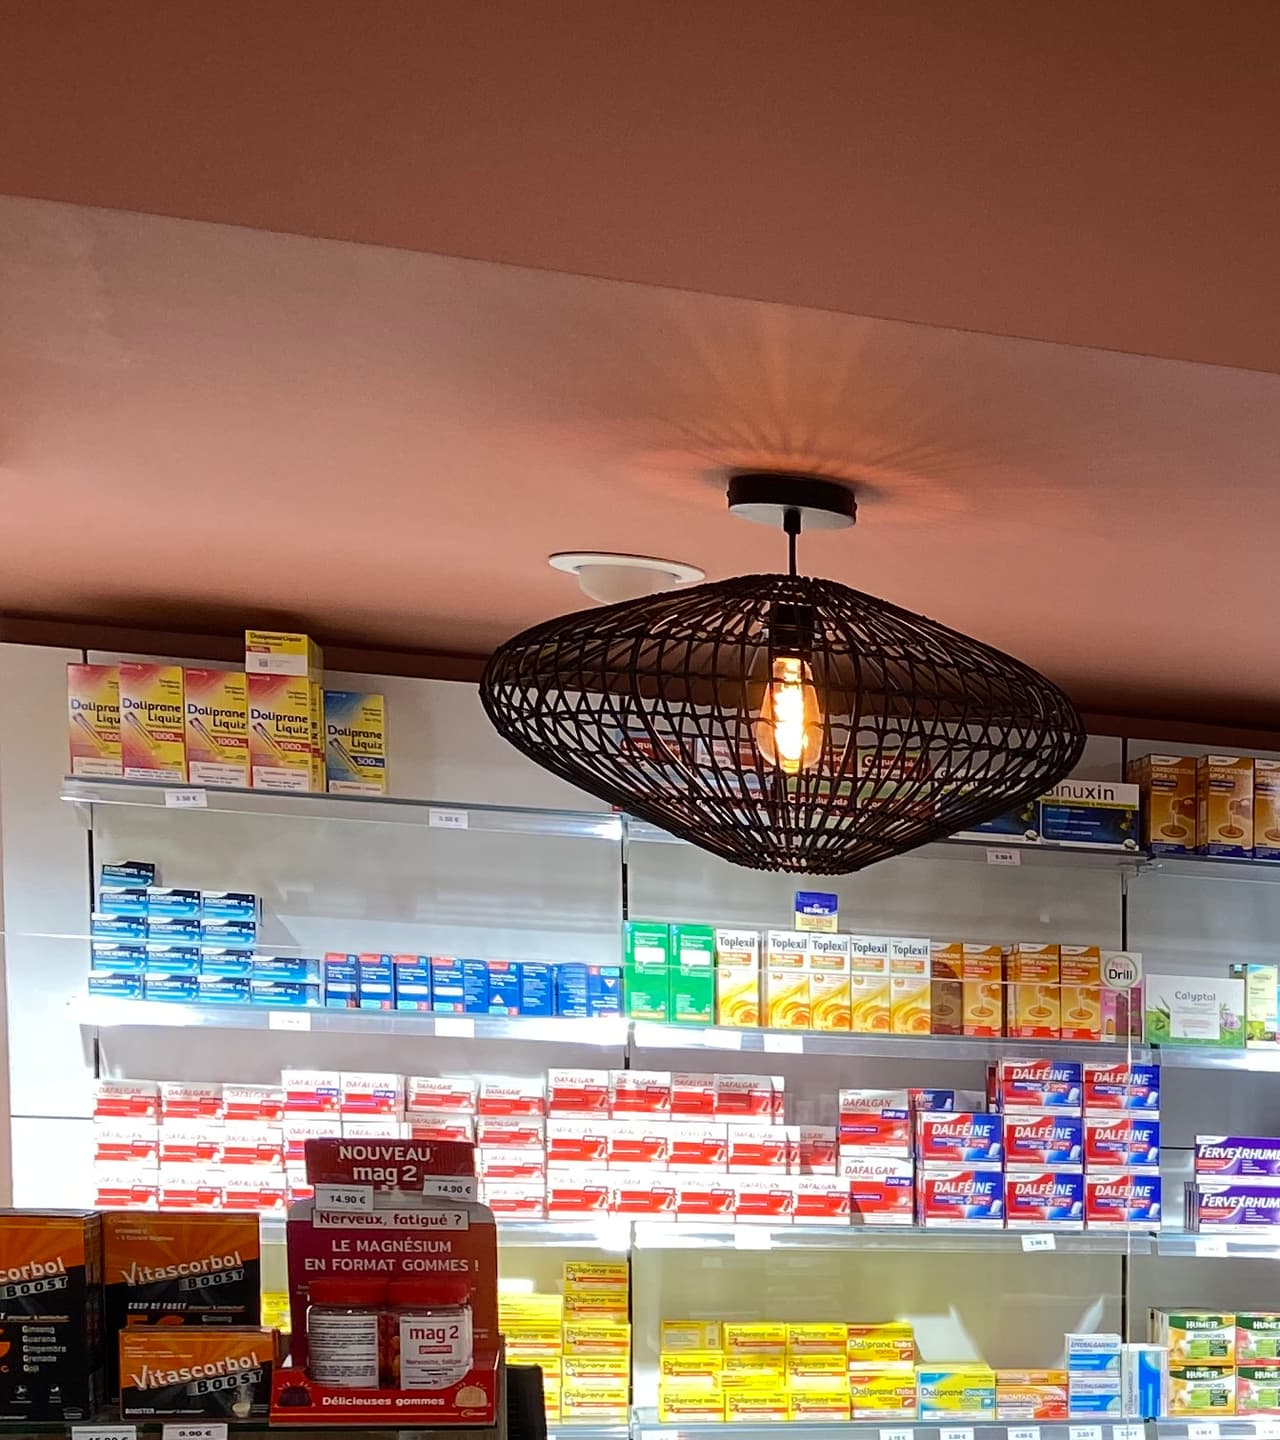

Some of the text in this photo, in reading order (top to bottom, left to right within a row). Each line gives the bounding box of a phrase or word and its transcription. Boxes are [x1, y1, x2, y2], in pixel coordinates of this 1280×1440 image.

[123, 698, 181, 713] Doliprane
[187, 704, 245, 718] Doliprane
[148, 711, 182, 724] Liquiz
[213, 716, 246, 730] Liquiz
[251, 709, 308, 724] Doliprane
[275, 721, 309, 735] Liquiz
[327, 725, 382, 739] Doliprane
[892, 944, 929, 957] Toplexil
[1108, 968, 1133, 980] Drill
[1012, 1065, 1070, 1081] DALFÉINE
[842, 1098, 891, 1107] DAFALGAN
[932, 1120, 990, 1136] DALFÉINE
[1015, 1124, 1071, 1138] DALFÉINE
[339, 1146, 430, 1161] NOUVEAU
[353, 1166, 417, 1186] mag 2
[845, 1165, 896, 1175] DAFALGAN
[437, 1185, 472, 1194] 14.90 €
[331, 1196, 366, 1204] 14.90 €
[320, 1213, 462, 1227] Nerveux, fatigué ?
[332, 1237, 451, 1252] LE MAGNÉSIUM
[122, 1251, 242, 1286] Vitascorbol
[305, 1259, 325, 1270] EN
[332, 1259, 394, 1271] FORMAT
[402, 1260, 468, 1272] GOMMES
[188, 1269, 244, 1289] BOOST
[6, 1277, 68, 1297] BOOST
[1186, 1320, 1218, 1329] HUMER
[409, 1326, 459, 1343] mag 2
[131, 1352, 260, 1391] Vitascorbol
[197, 1370, 263, 1394] BOOST
[322, 1396, 445, 1407] Délicieuses gommes
